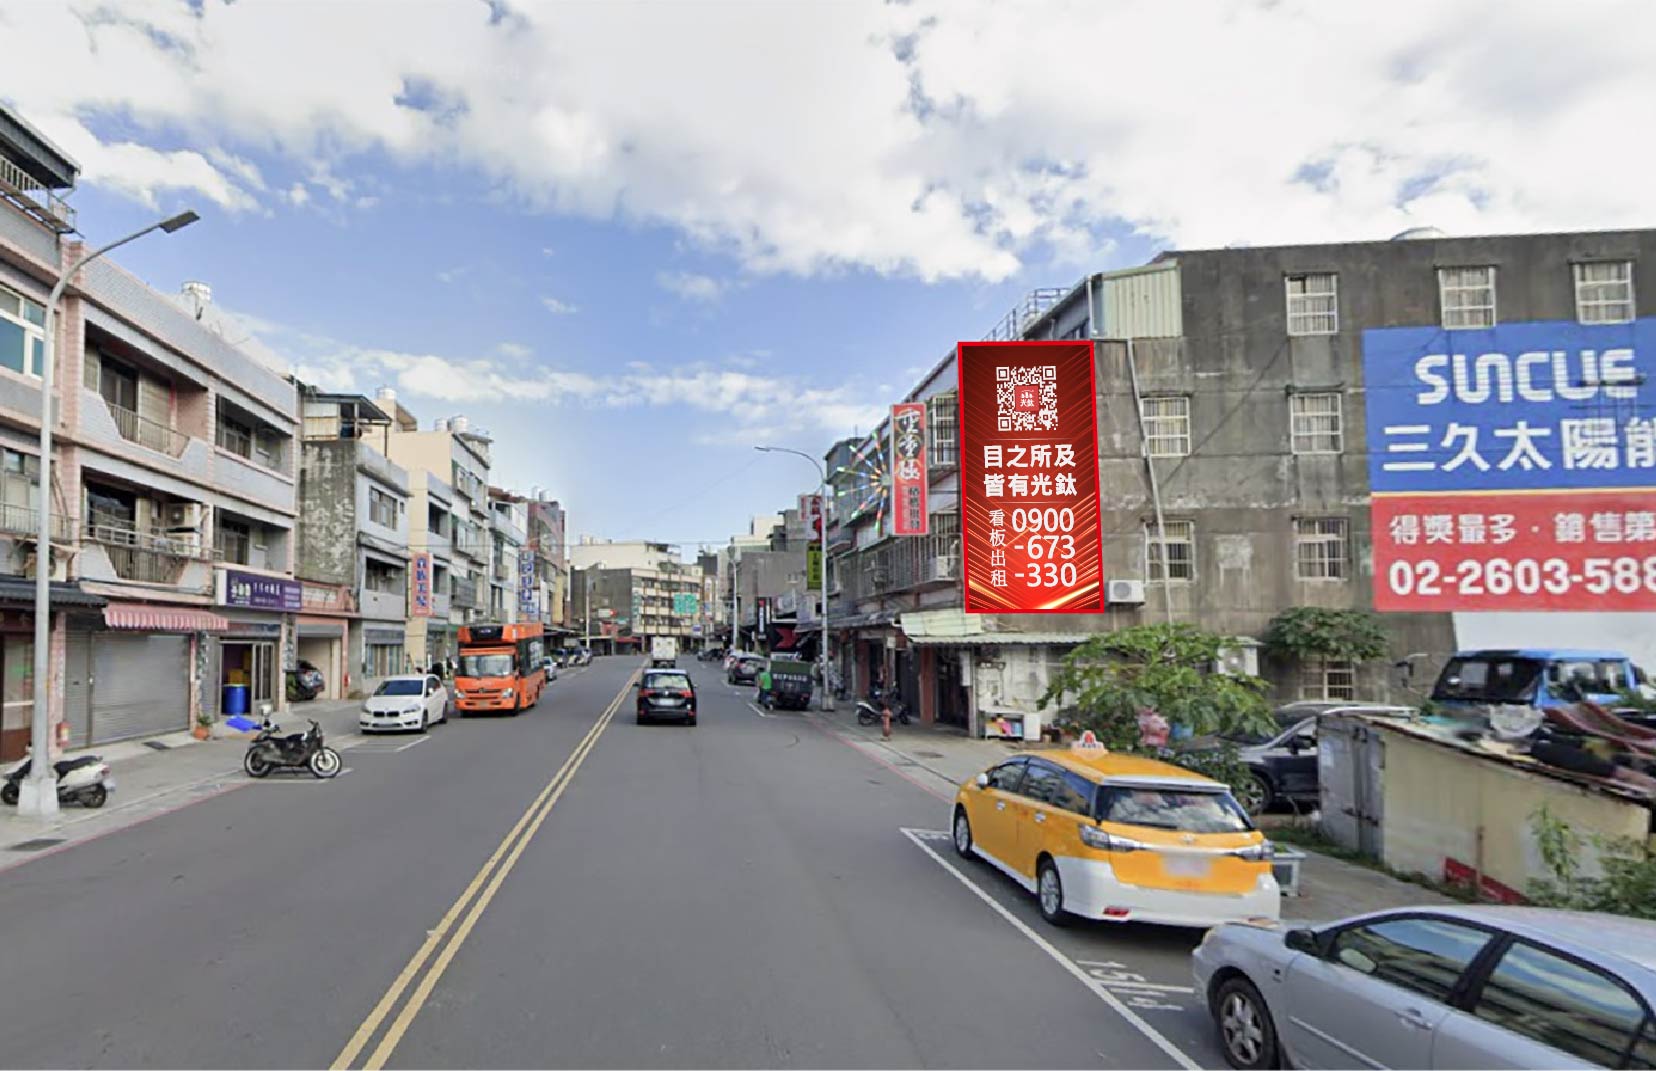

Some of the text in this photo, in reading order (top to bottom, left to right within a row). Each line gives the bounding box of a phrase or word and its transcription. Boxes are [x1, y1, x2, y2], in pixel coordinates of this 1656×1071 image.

[984, 445, 1077, 469] 目之所及
[984, 473, 1078, 498] 皆有光鈦
[1012, 508, 1076, 534] 0900
[989, 509, 1008, 588] 看板出租
[1015, 535, 1077, 561] -673
[1015, 563, 1078, 588] -330
